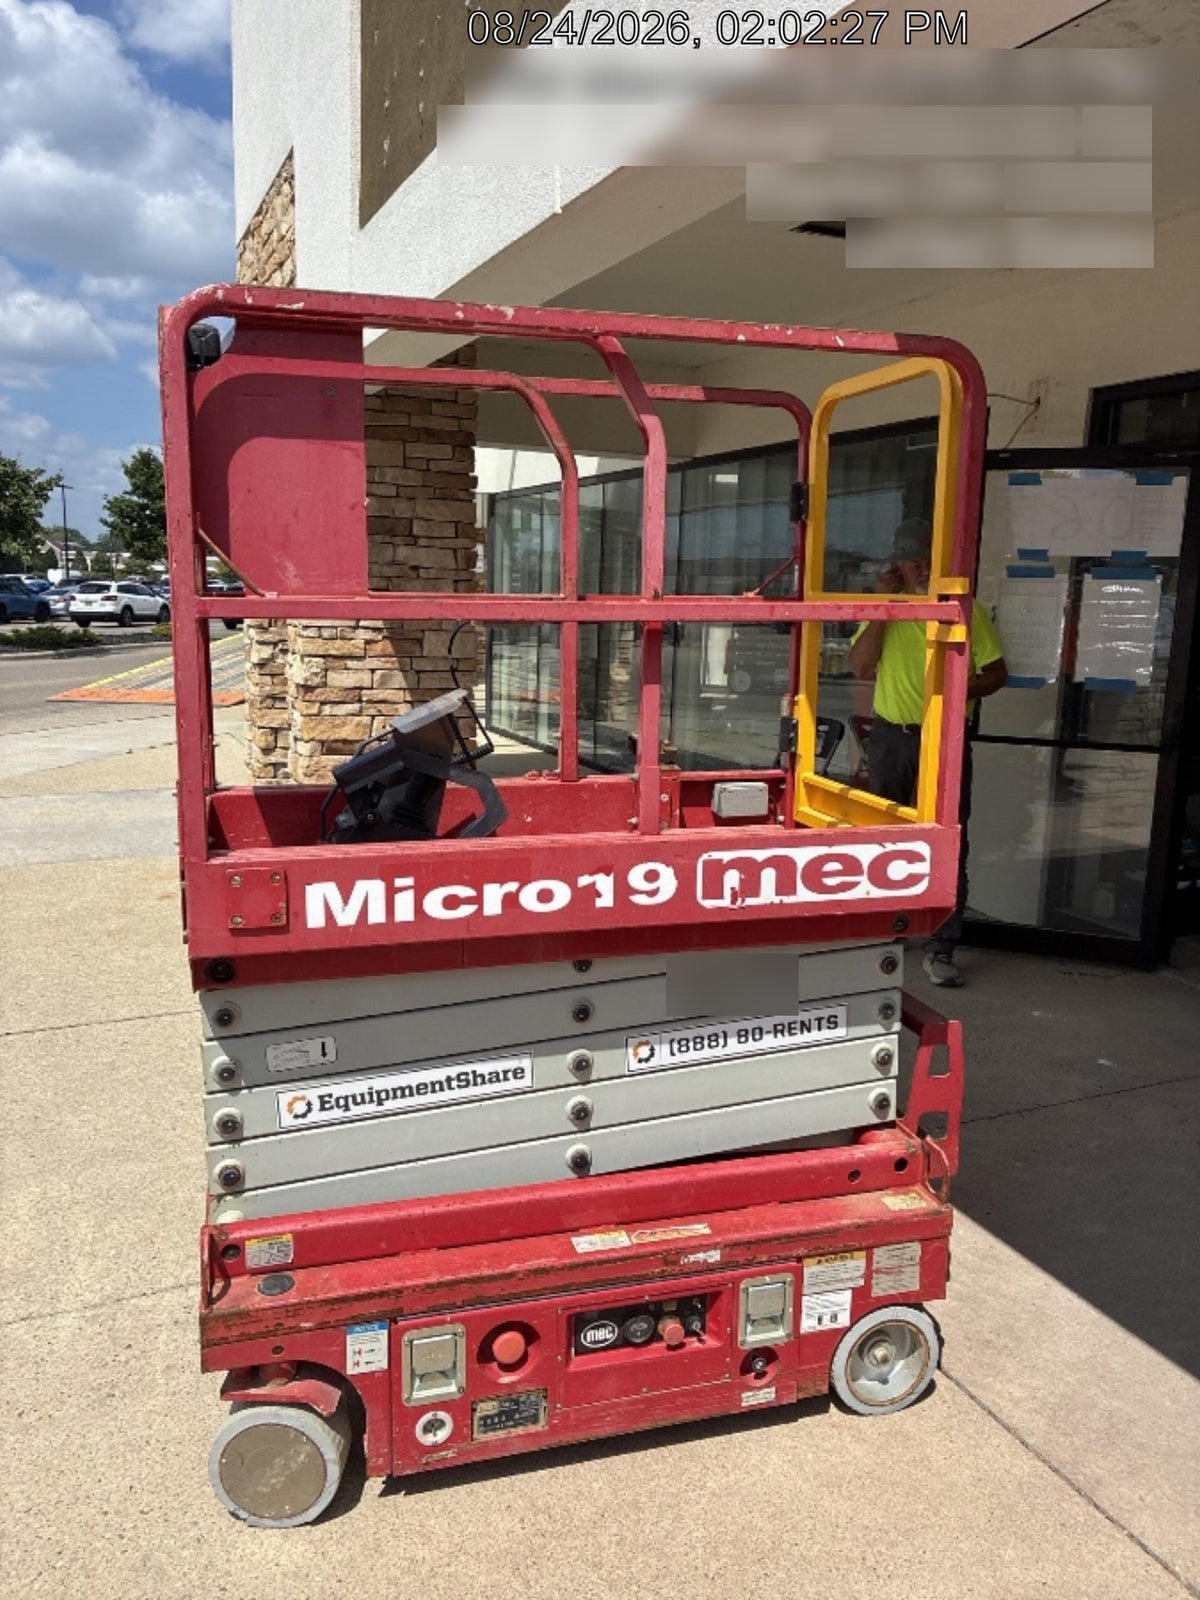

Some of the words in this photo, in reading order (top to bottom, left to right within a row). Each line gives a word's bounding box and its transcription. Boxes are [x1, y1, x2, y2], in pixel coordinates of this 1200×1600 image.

[700, 848, 931, 902] mec
[669, 1031, 728, 1057] (888)
[317, 1066, 526, 1113] EquipmentShare
